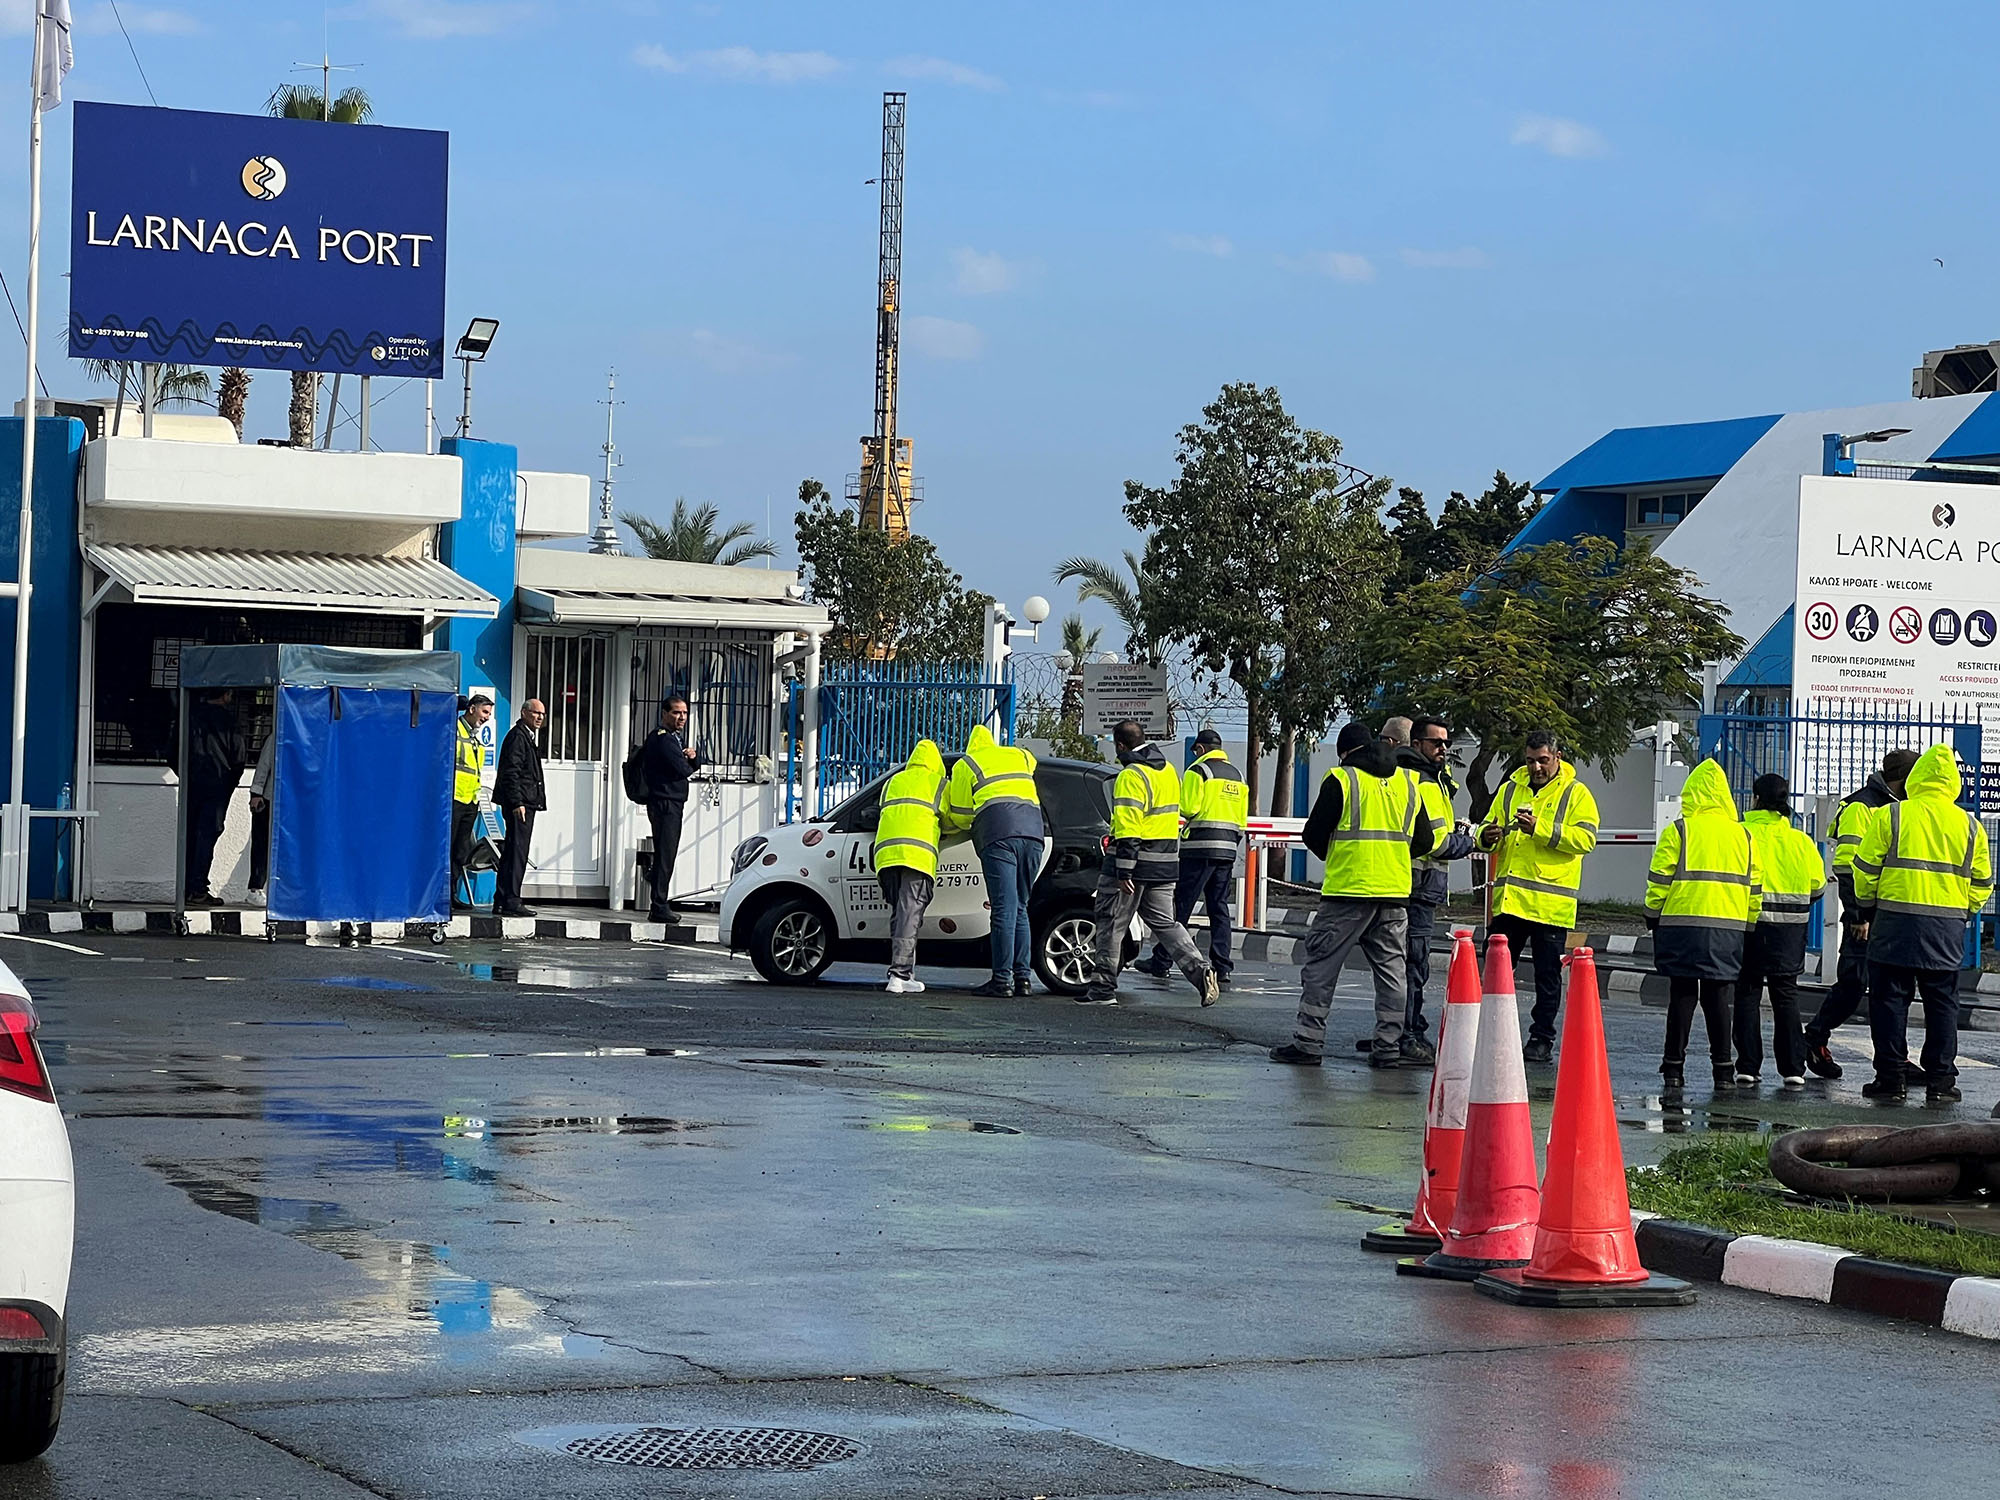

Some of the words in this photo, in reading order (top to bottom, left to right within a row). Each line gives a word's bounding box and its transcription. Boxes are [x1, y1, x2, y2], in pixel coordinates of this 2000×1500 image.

[86, 211, 300, 259] LARNACA
[318, 226, 434, 268] PORT
[95, 328, 111, 336] +357
[126, 330, 134, 338] 77
[214, 337, 303, 350] www.larnaca-port.com.cy
[388, 336, 417, 344] Operated
[417, 337, 427, 347] by:
[388, 346, 429, 357] KITION
[1836, 532, 1964, 563] LARNACA
[1809, 576, 1840, 587] ΚΑΛΩΣ
[1842, 578, 1878, 588] ΗΡΘΑΤΕ
[1886, 580, 1933, 591] WELCOME
[1811, 611, 1832, 631] 30
[1811, 654, 1847, 665] ΠΕΡΙΟΧΗ
[1849, 656, 1916, 668] ΠΕΡΙΟΡΙΣΜΕΝΗΣ
[1957, 661, 2000, 671] RESTRICTE
[1839, 668, 1887, 679] ΠΡΟΣΒΑΣΗΣ
[1939, 675, 1963, 683] ACCESS
[1965, 676, 1999, 685] PROVIDED
[1811, 683, 1839, 692] ΕΙΣΟΔΟΣ
[1840, 685, 1881, 694] ΕΠΙΤΡΕΠΕΤΑΙ
[1883, 687, 1905, 695] ΜΟΝΟ
[1907, 688, 1914, 696] ΣΕ
[1970, 790, 1988, 798] PRT
[947, 875, 961, 887] 79
[965, 875, 980, 887] 70
[850, 885, 885, 901] FEE
